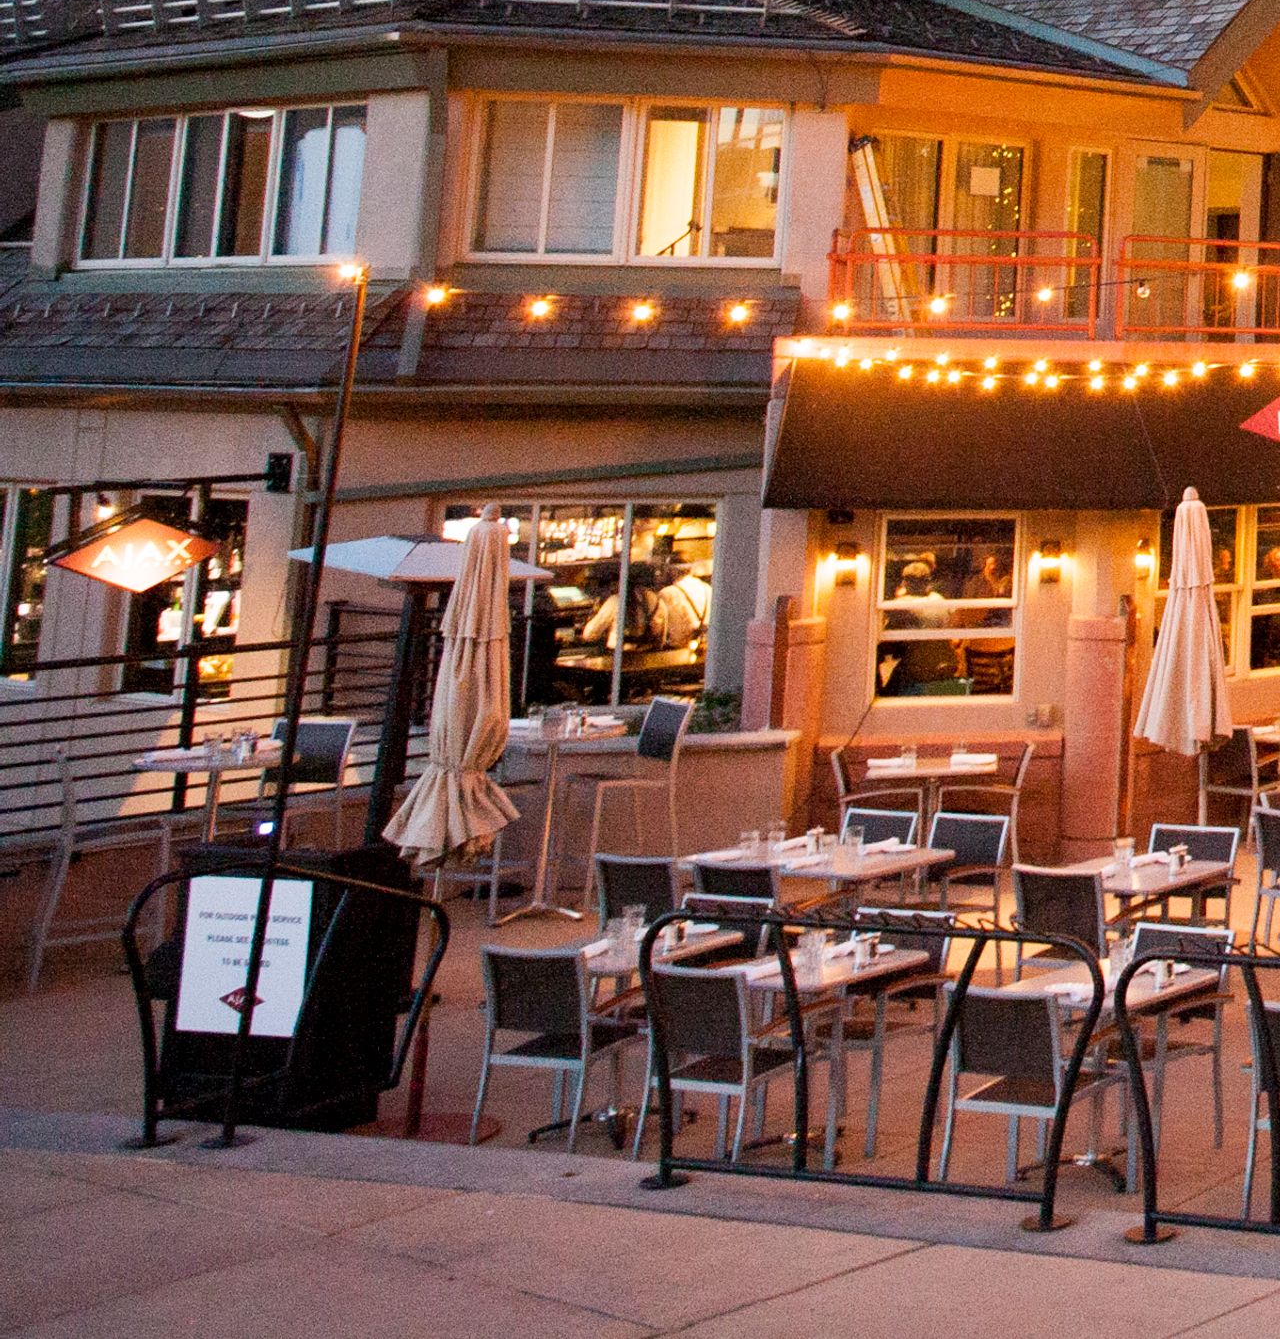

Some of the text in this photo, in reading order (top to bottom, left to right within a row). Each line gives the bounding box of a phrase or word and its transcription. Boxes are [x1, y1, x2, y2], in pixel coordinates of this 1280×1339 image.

[90, 537, 193, 570] AJAX
[272, 915, 302, 924] SERVICE
[207, 934, 234, 943] PLEASE
